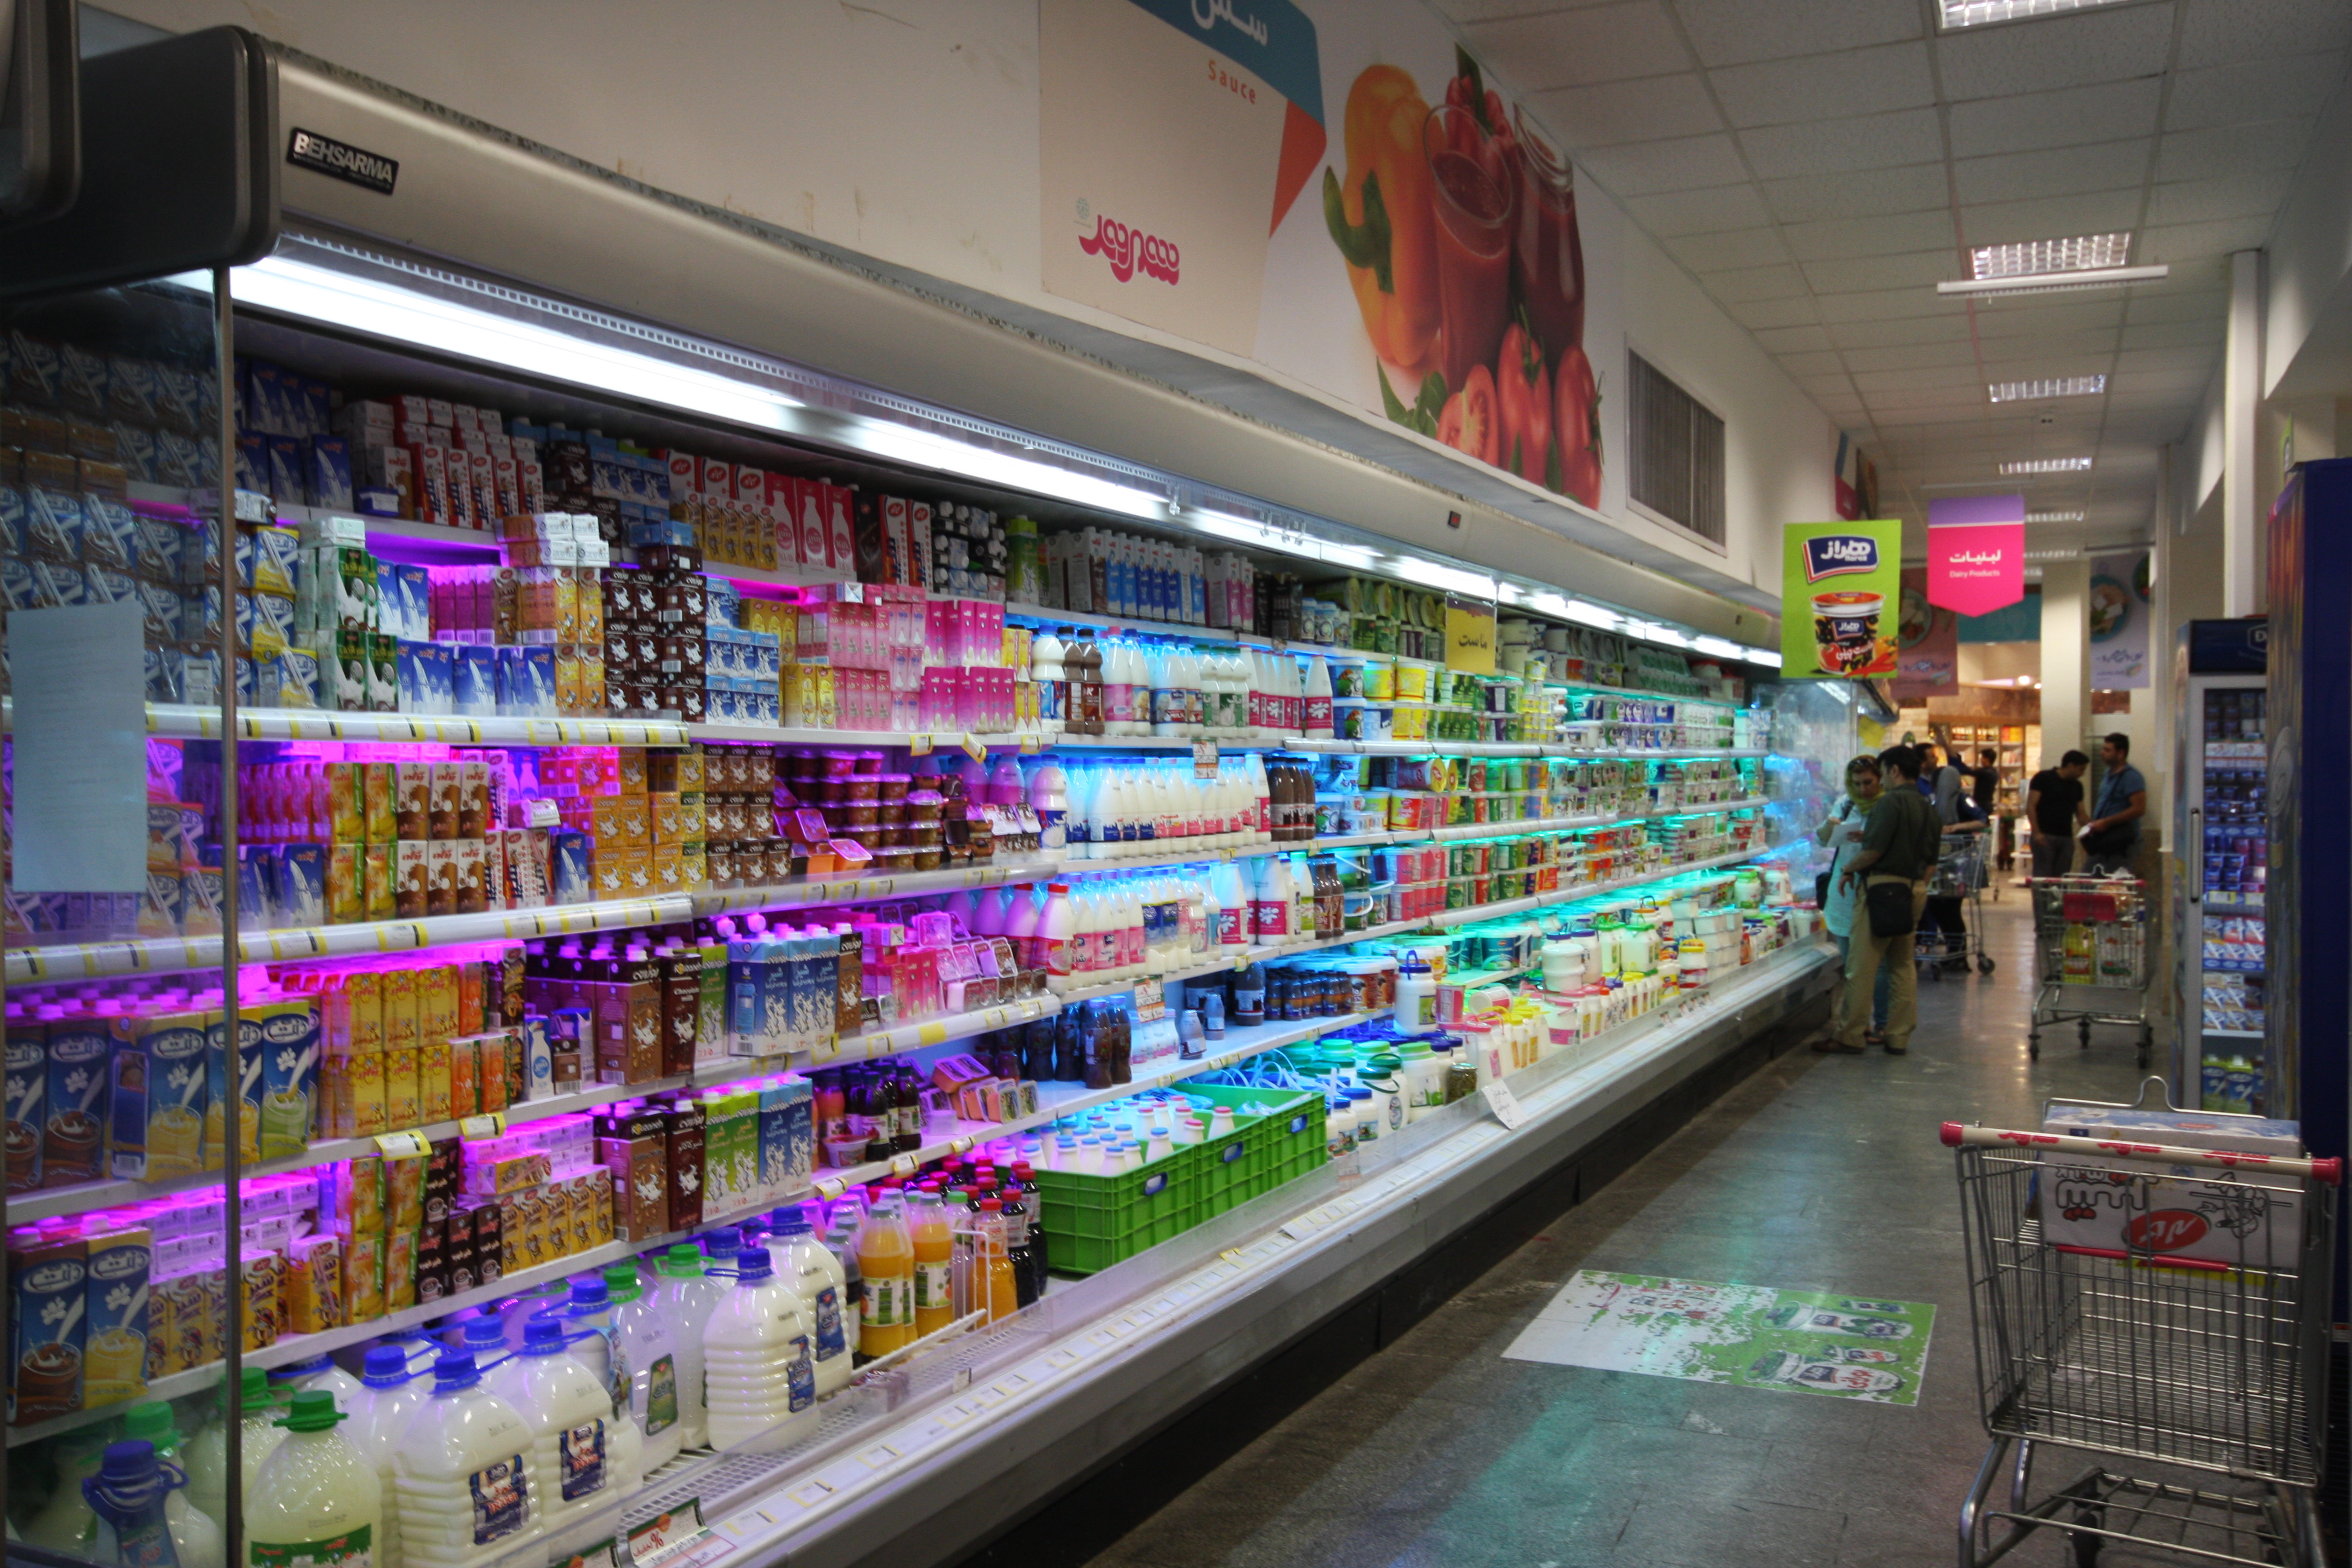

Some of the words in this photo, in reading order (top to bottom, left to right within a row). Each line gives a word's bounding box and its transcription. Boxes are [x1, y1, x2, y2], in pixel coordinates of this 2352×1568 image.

[1208, 60, 1256, 104] Sauce
[293, 131, 393, 183] BEHSARMA
[1949, 549, 2001, 566] لبنیات
[1949, 570, 1968, 579] Dairy
[1459, 633, 1488, 650] ماست
